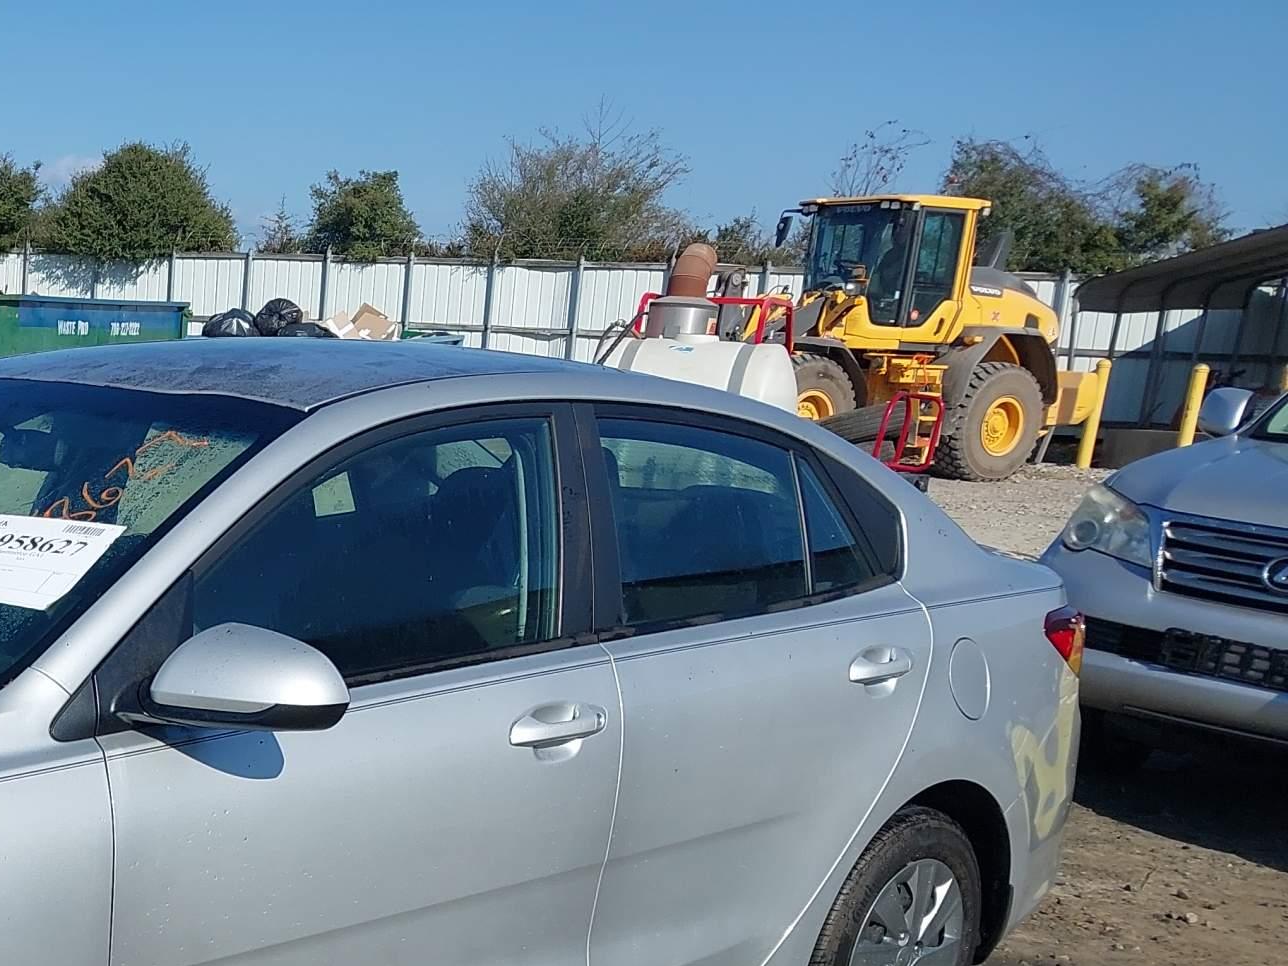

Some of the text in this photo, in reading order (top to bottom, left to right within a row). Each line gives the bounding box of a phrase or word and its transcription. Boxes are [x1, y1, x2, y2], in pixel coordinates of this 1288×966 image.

[970, 286, 1002, 296] VOLVO
[57, 319, 89, 336] WASTE PRO
